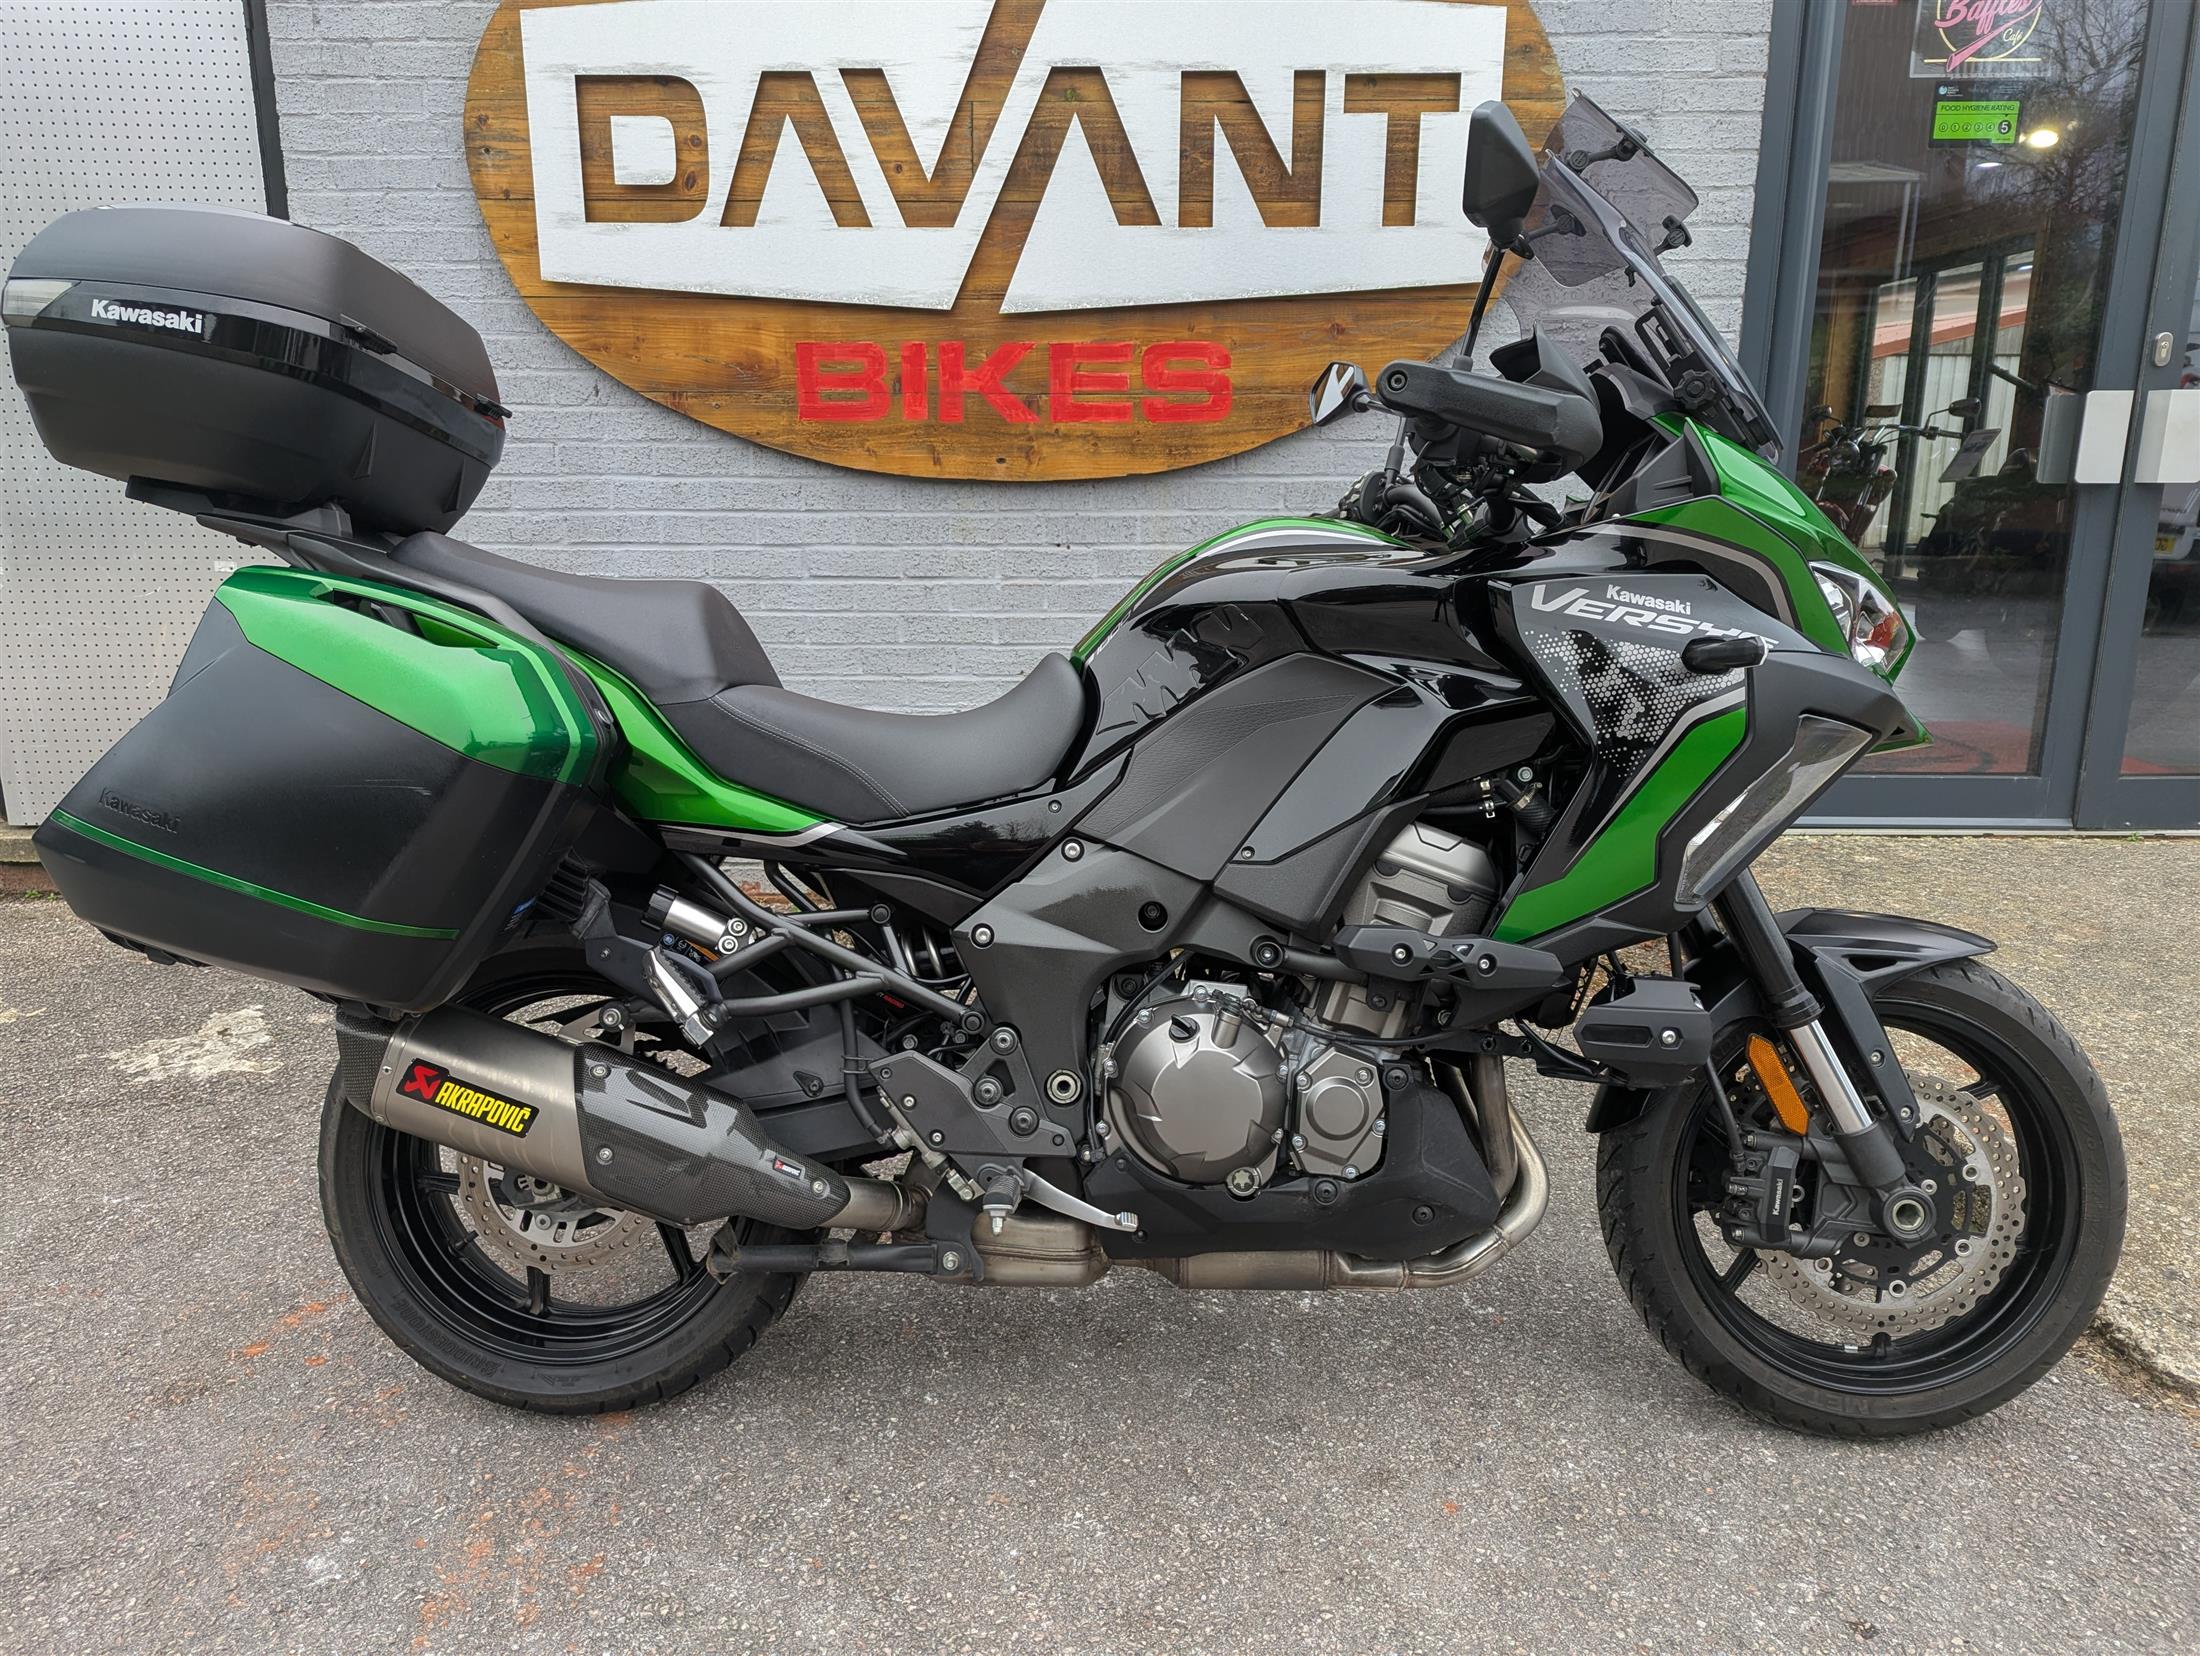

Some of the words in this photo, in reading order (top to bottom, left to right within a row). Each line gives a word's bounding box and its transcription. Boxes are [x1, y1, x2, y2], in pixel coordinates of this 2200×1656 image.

[2000, 121, 2009, 133] 5
[574, 65, 1462, 229] DAVANT
[91, 298, 203, 334] Kawasaki
[796, 340, 1232, 424] BIKES
[1606, 584, 1691, 616] Kawasaki
[98, 787, 181, 834] Kawasaki
[1772, 1178, 1784, 1216] Kawasaki
